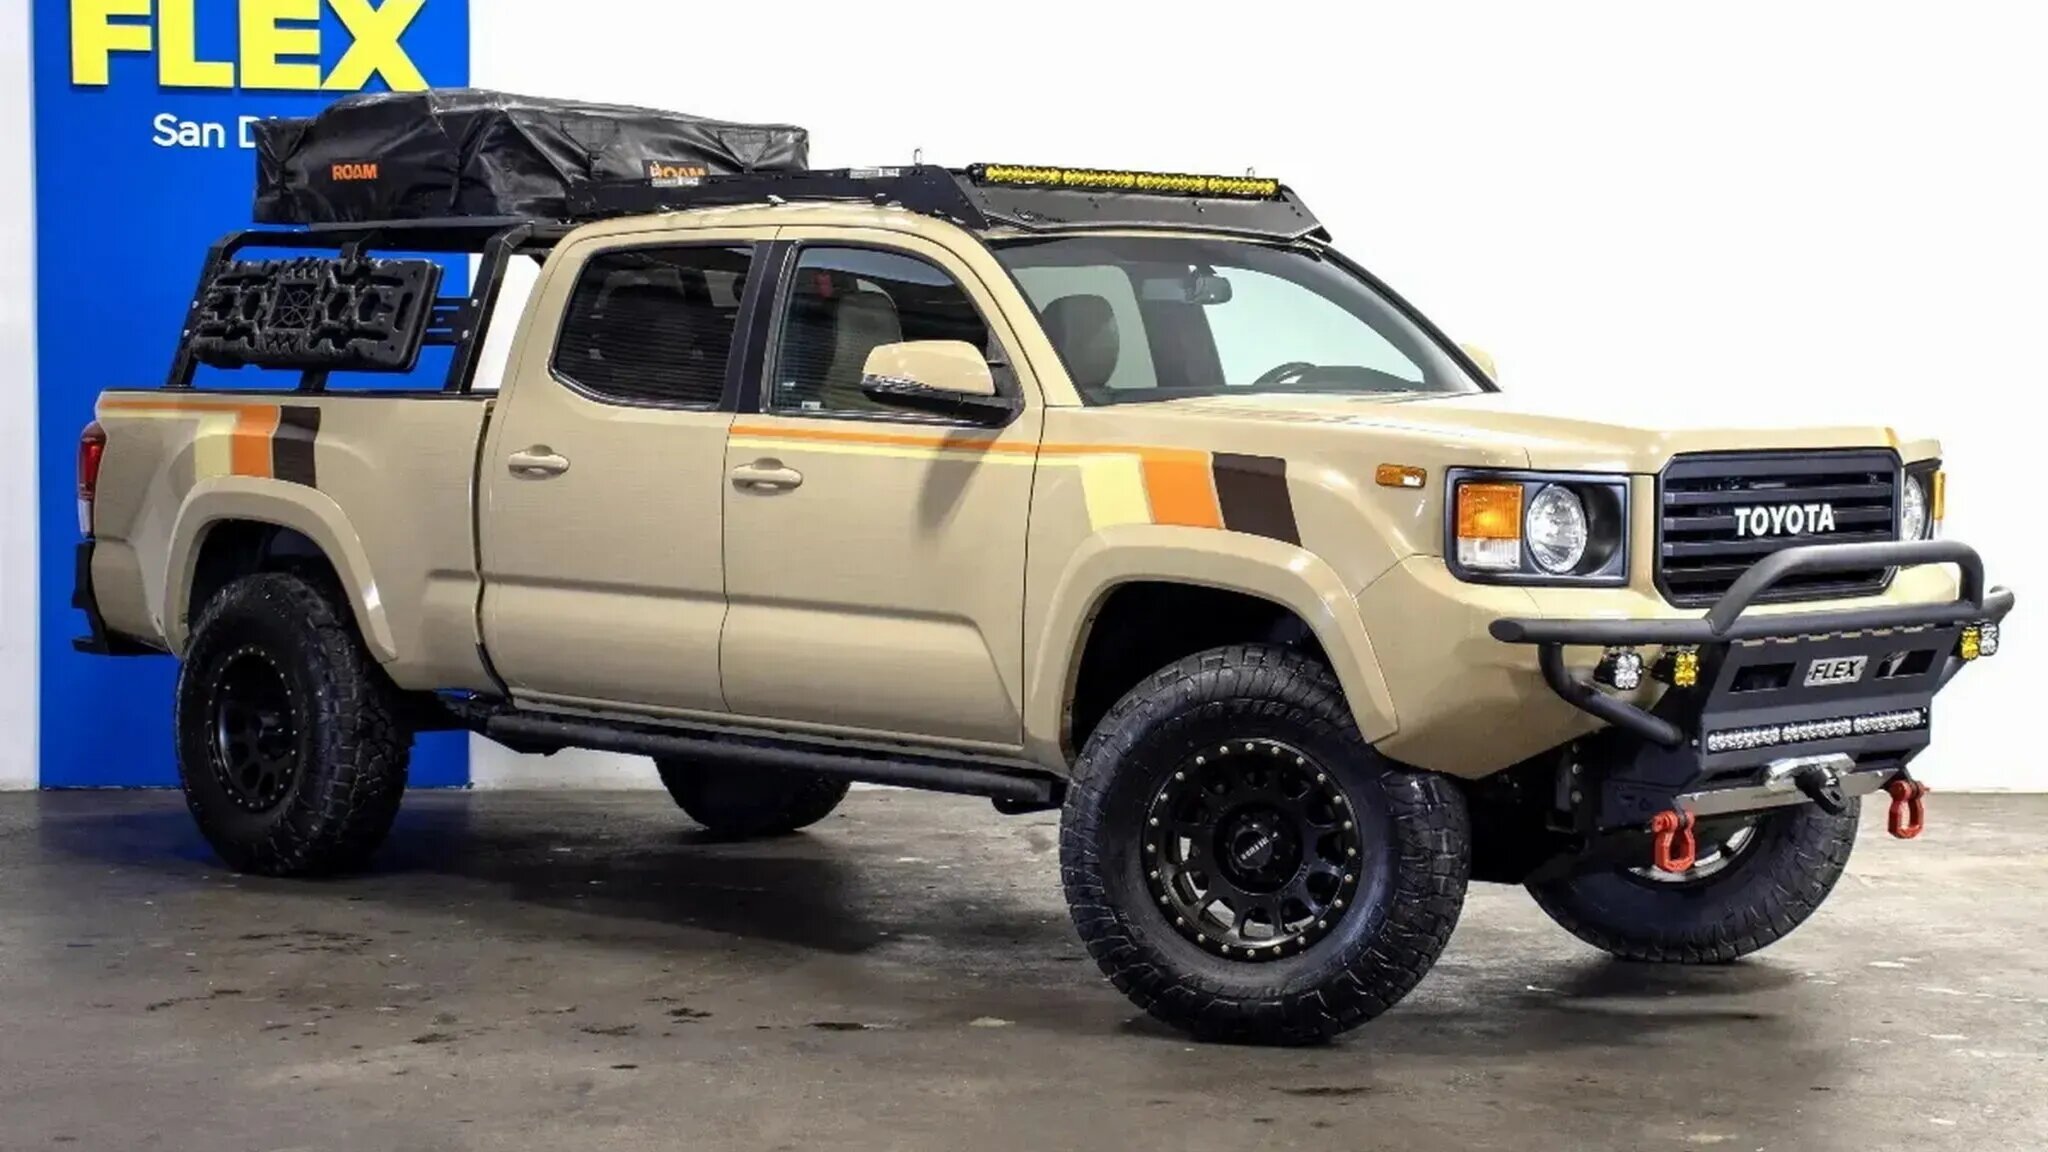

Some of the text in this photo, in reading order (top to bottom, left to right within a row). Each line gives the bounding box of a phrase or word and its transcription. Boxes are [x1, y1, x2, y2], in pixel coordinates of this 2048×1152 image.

[71, 0, 430, 91] FLEX
[152, 113, 226, 148] San
[331, 164, 377, 181] ROAM
[1734, 503, 1836, 536] TOYOTA
[1811, 660, 1860, 681] FLEX
